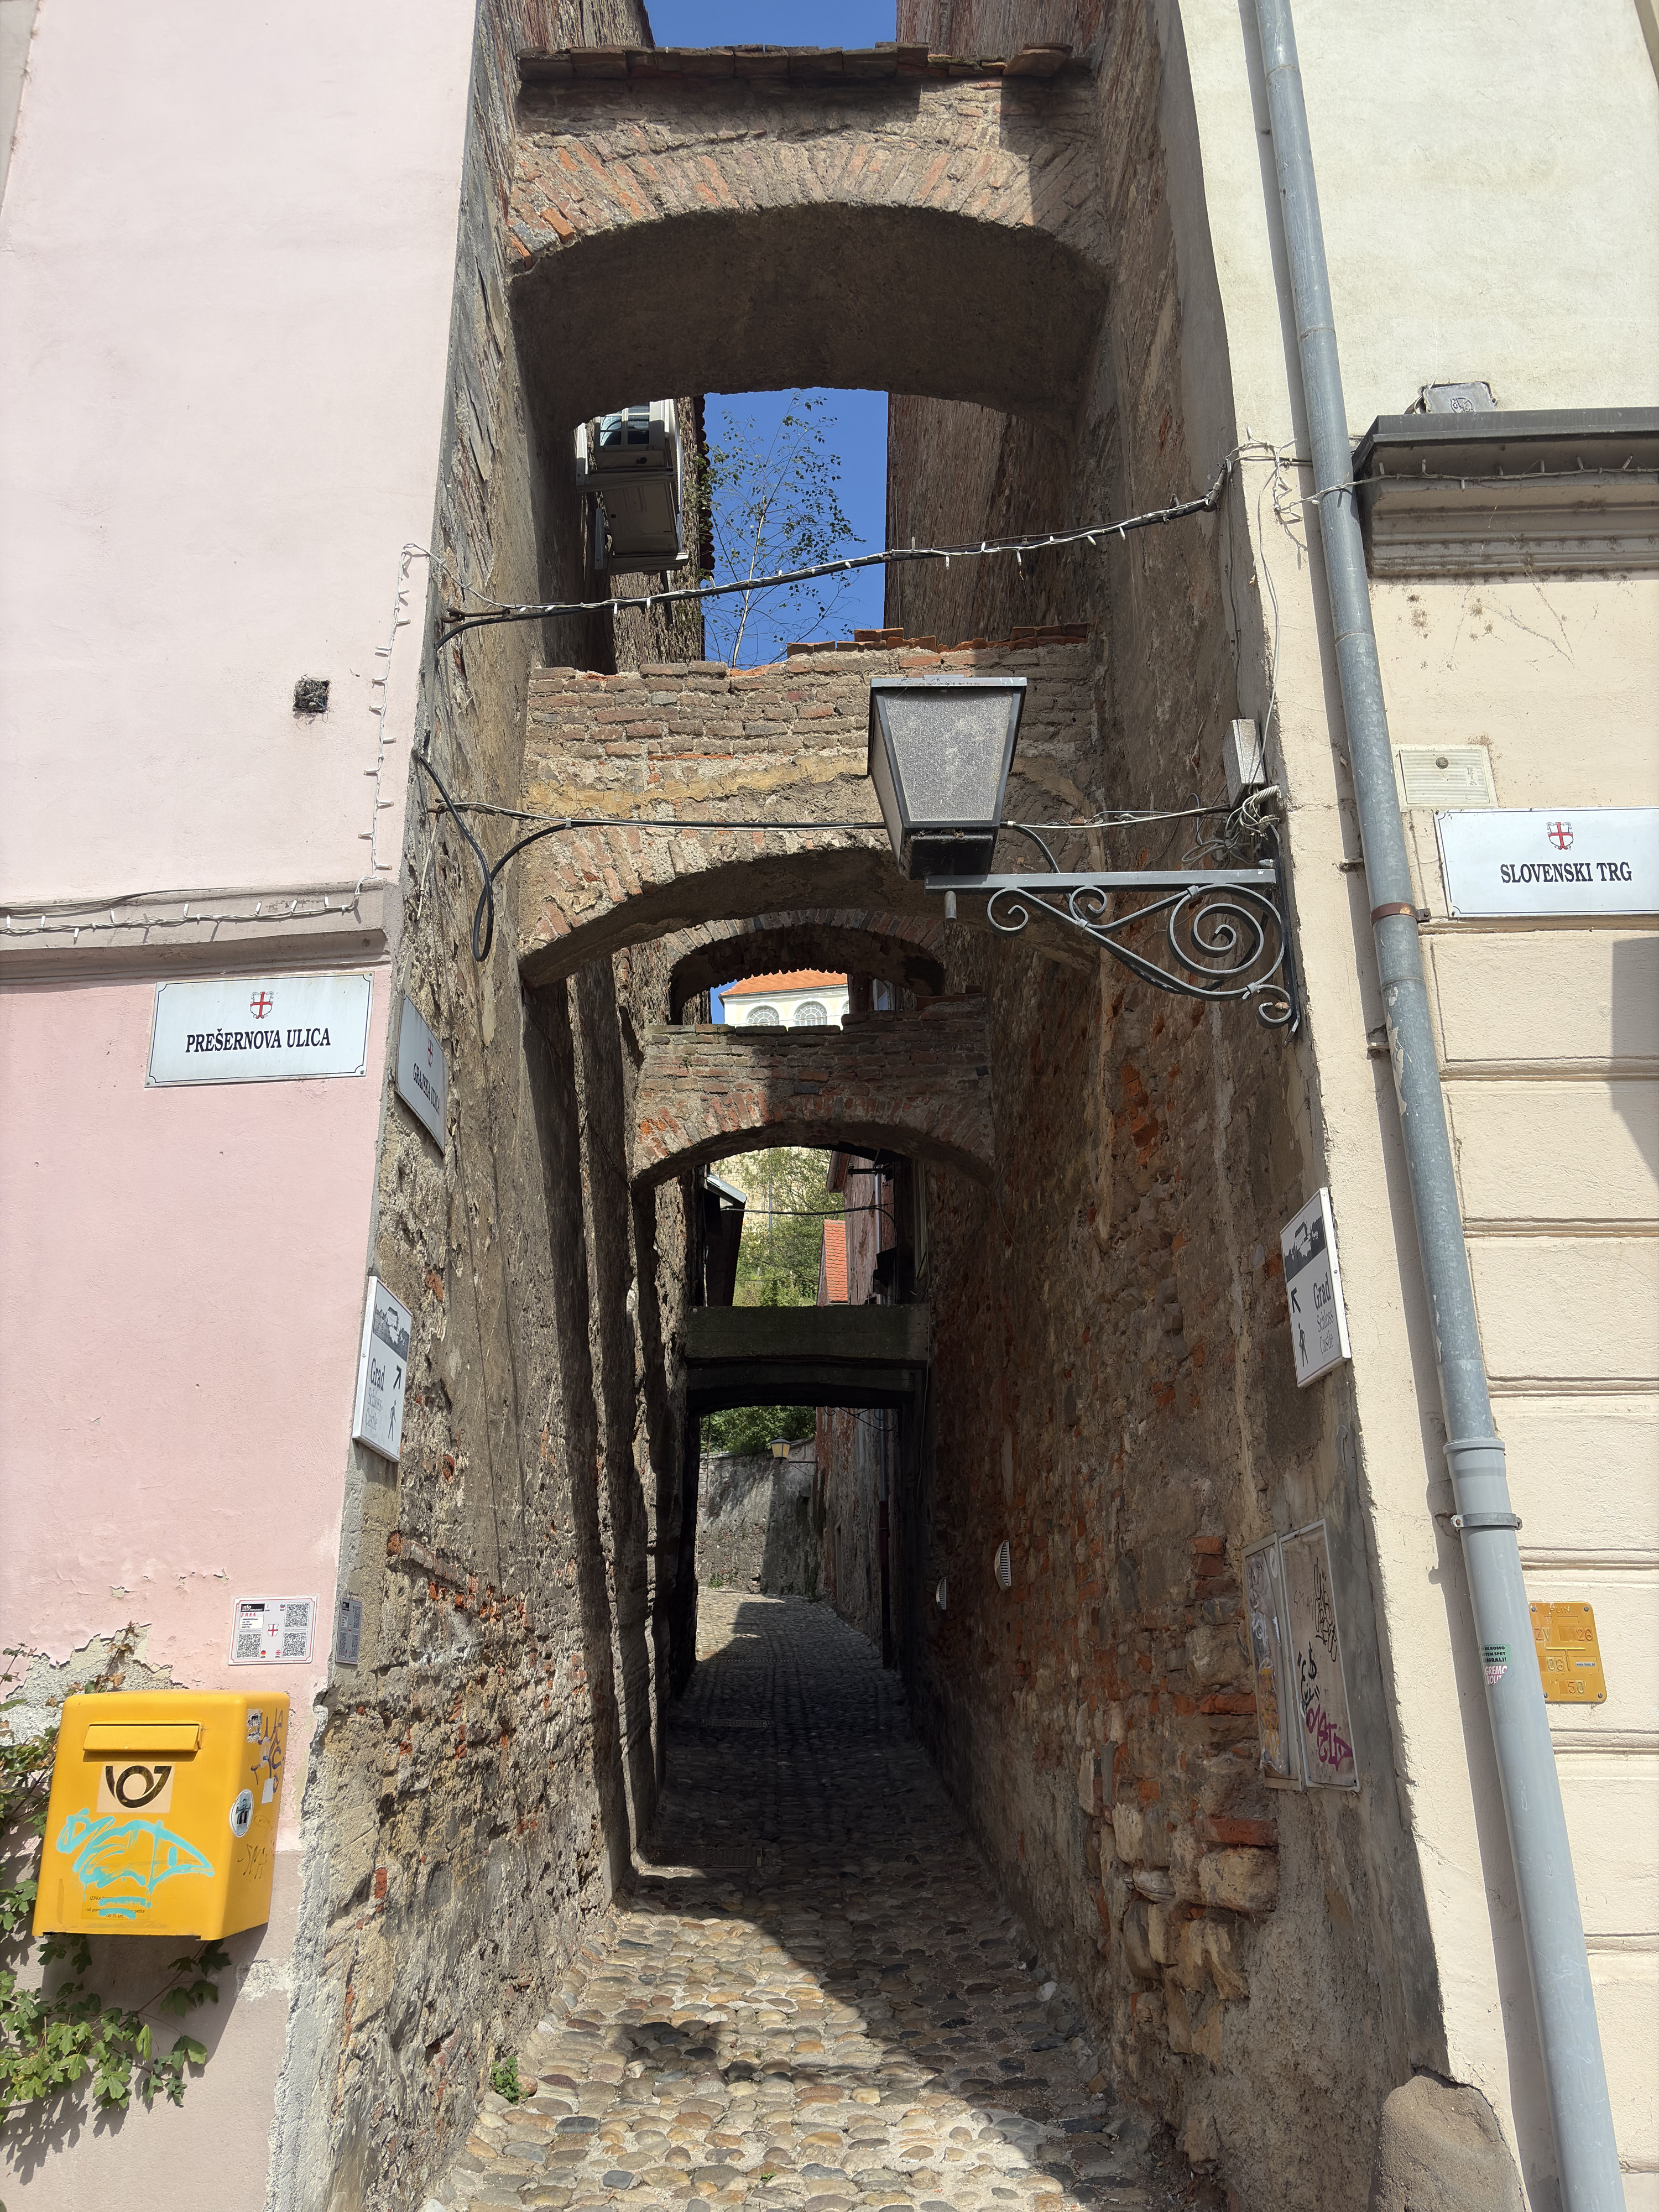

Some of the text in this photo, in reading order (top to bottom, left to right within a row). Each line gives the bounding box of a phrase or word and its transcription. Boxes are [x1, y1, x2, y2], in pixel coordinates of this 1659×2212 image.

[1500, 862, 1632, 883] SLOVENSKI TRG
[185, 1027, 331, 1053] PREŠERNOVA ULICA
[413, 1062, 440, 1116] GRAJSKA ULICA
[1313, 1271, 1331, 1310] Grad
[1316, 1309, 1334, 1333] Schloss
[1319, 1330, 1334, 1354] Castle
[371, 1358, 385, 1392] Grad
[367, 1387, 382, 1412] Schloss
[366, 1407, 378, 1431] Castle
[1576, 1627, 1593, 1641] 26
[1485, 1665, 1508, 1676] GREMO
[1547, 1658, 1564, 1671] 06
[1567, 1681, 1584, 1694] 50
